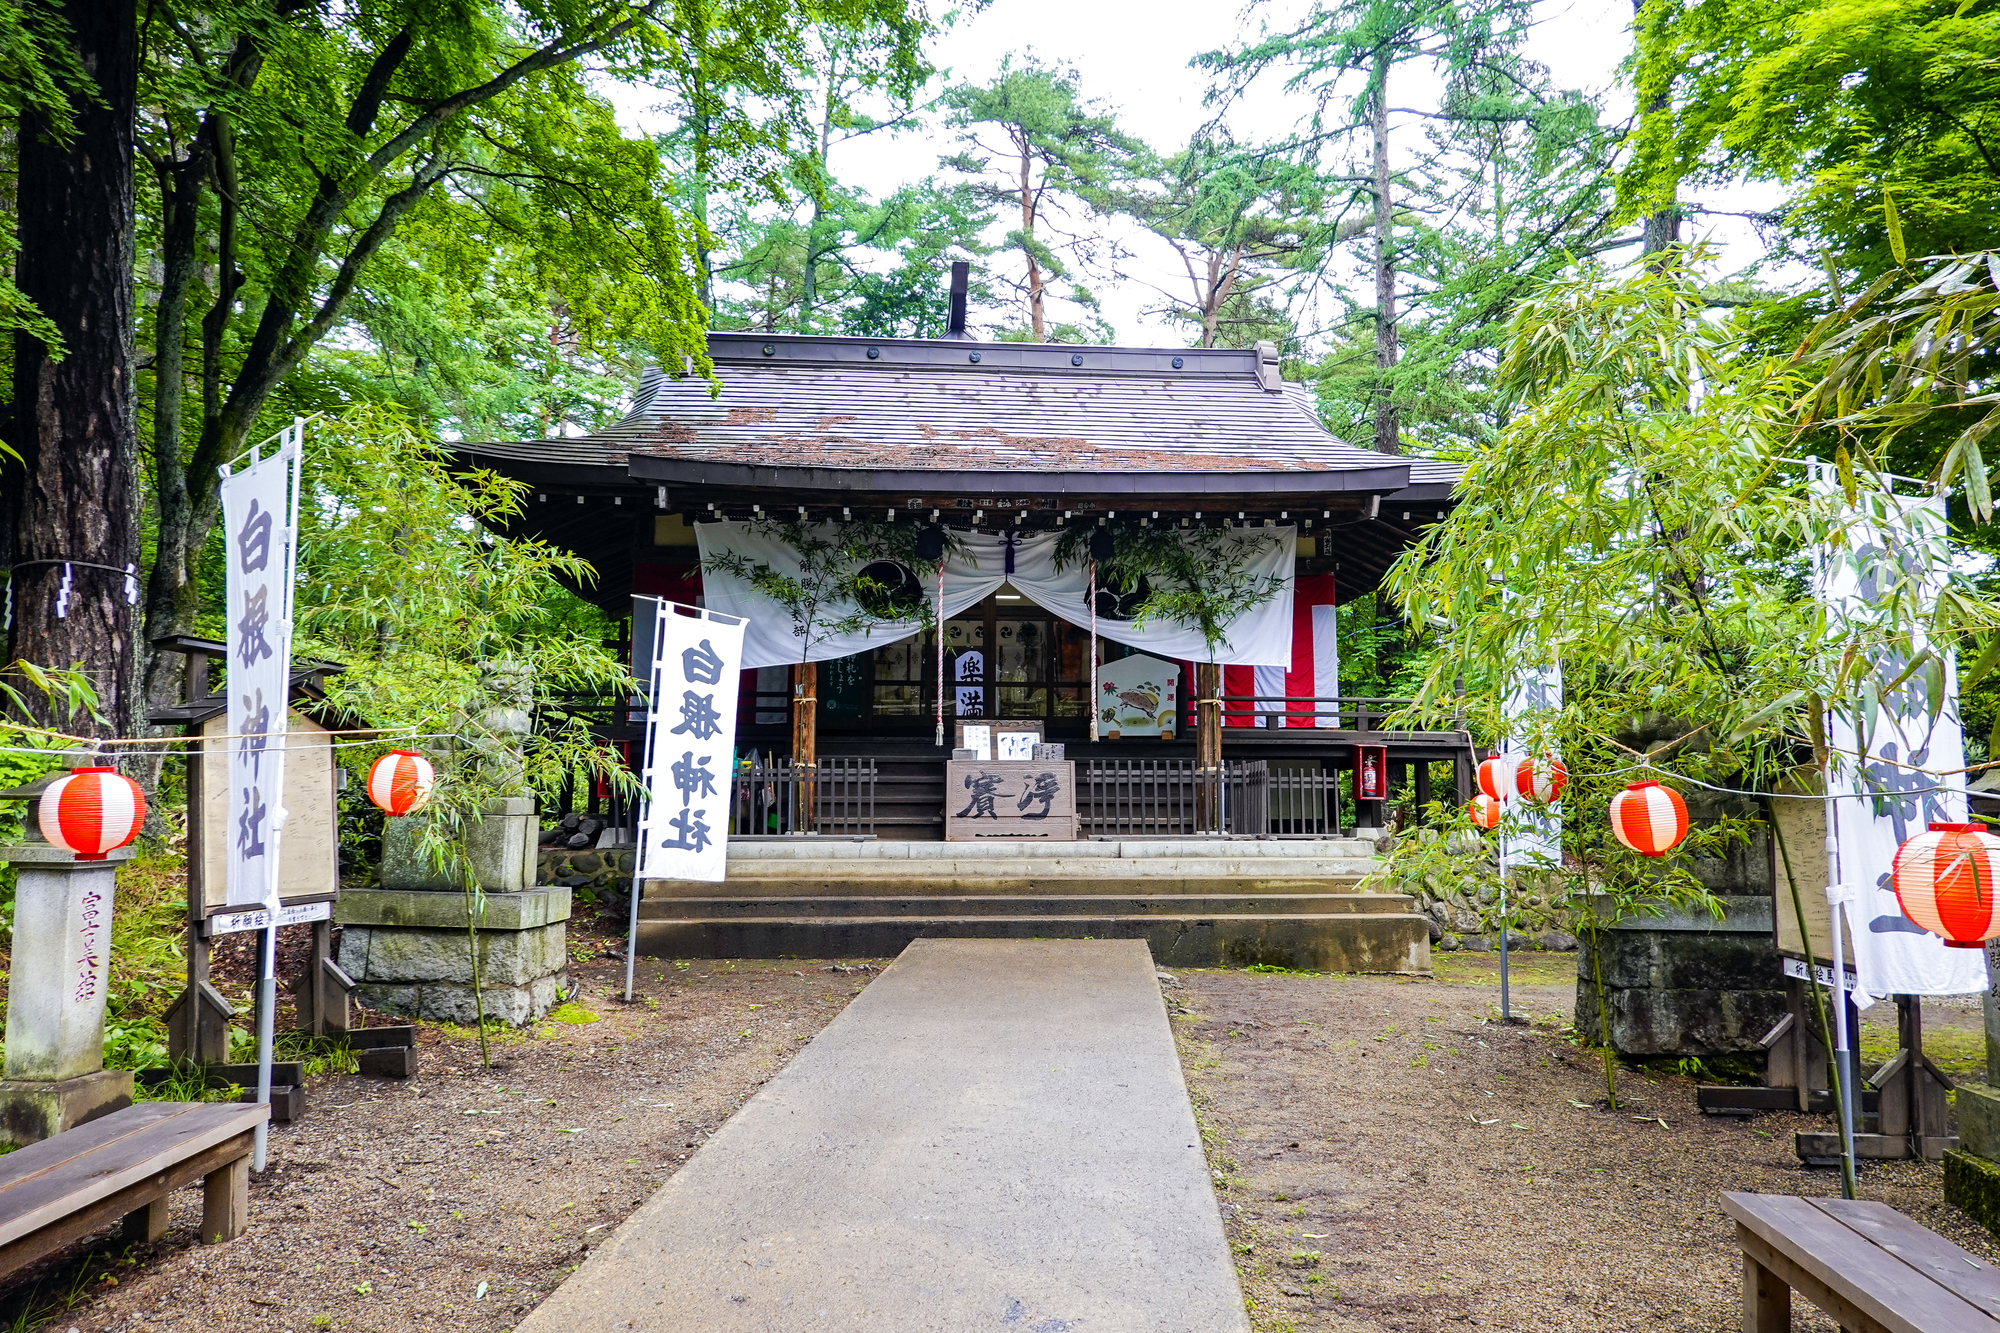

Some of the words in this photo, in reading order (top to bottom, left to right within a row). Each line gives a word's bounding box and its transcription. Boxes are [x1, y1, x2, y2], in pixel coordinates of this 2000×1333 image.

[237, 497, 273, 863] 白根神社
[1166, 679, 1175, 701] 開運
[230, 911, 269, 930] 祈願絵
